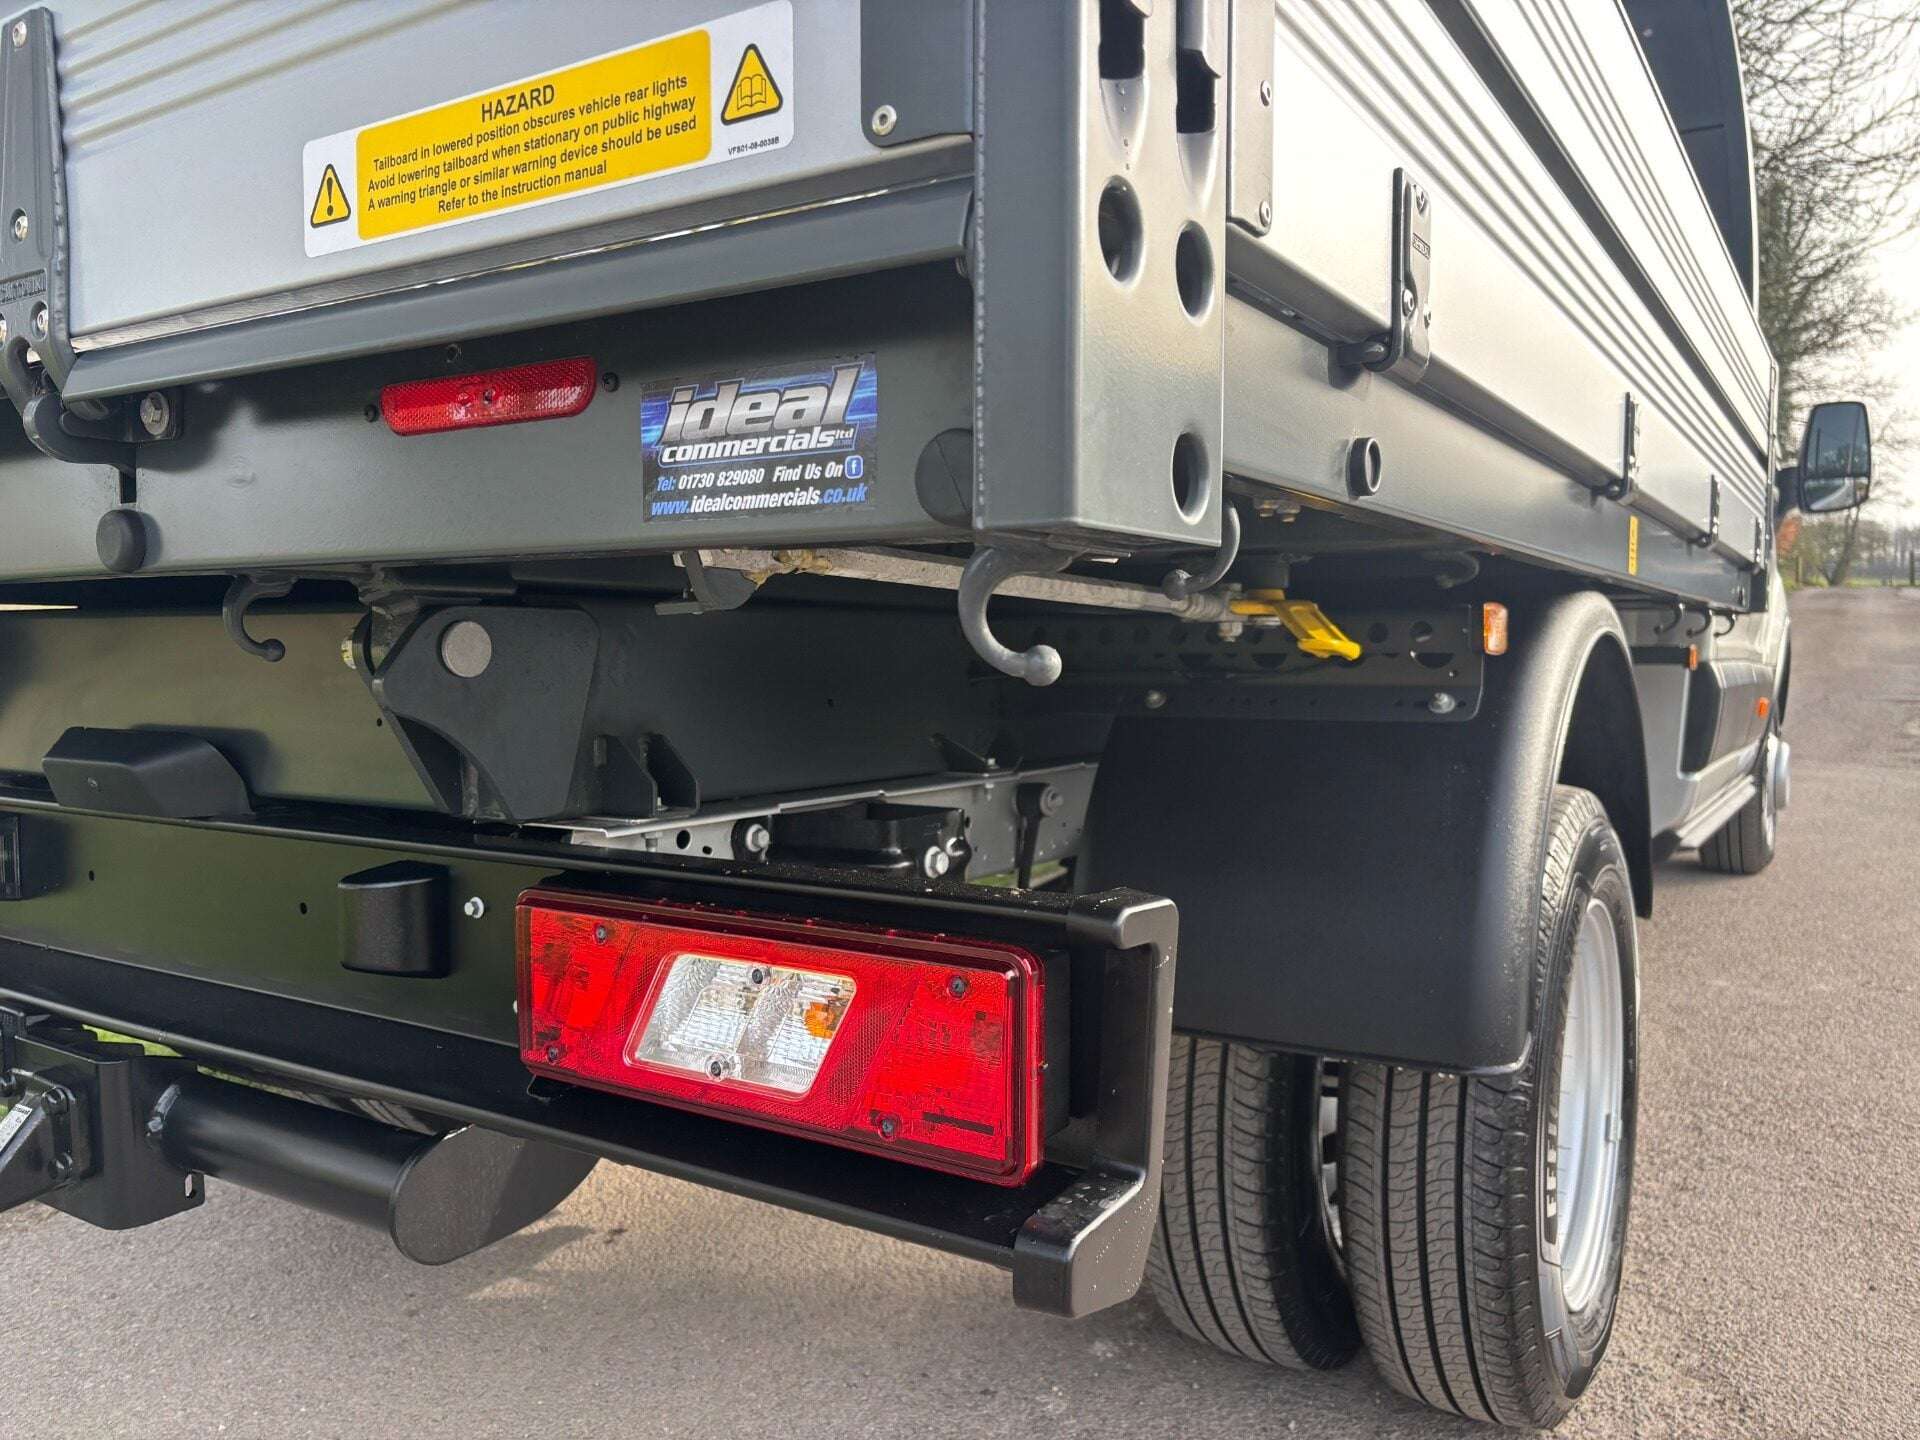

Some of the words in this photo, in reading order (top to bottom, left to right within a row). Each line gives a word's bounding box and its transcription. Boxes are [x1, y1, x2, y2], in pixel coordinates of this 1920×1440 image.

[373, 148, 418, 172] Tailboard
[420, 147, 430, 159] in
[432, 134, 473, 156] lowered
[476, 123, 520, 148] position
[523, 108, 576, 132] obscures
[579, 94, 621, 116] vehicle
[624, 86, 650, 104] rear
[652, 75, 688, 98] lights
[481, 84, 555, 123] HAZARD
[367, 174, 395, 193] Avoid
[398, 163, 440, 186] lowering
[443, 149, 489, 173] tailboard
[491, 141, 521, 160] when
[523, 126, 580, 152] stationary
[583, 122, 599, 136] on
[602, 110, 640, 135] public
[643, 96, 696, 121] highway
[367, 198, 376, 211] A
[377, 189, 416, 210] warning
[418, 178, 457, 199] triangle
[459, 176, 471, 189] or
[473, 165, 510, 186] similar
[511, 154, 557, 176] warning
[560, 144, 598, 163] device
[601, 129, 643, 153] should
[646, 127, 662, 141] be
[665, 115, 697, 137] used
[437, 197, 466, 214] Refer
[468, 192, 479, 206] to
[481, 188, 498, 204] the
[501, 174, 561, 199] instruction
[564, 160, 608, 184] manual
[657, 363, 863, 444] ideal
[661, 426, 836, 463] commercials
[651, 485, 868, 517] www.idealcommercials.co.uk
[656, 476, 676, 492] Tel:
[678, 473, 714, 490] 01730
[716, 468, 765, 488] 829080
[772, 464, 802, 483] Find
[805, 463, 822, 480] Us
[825, 461, 844, 478] On
